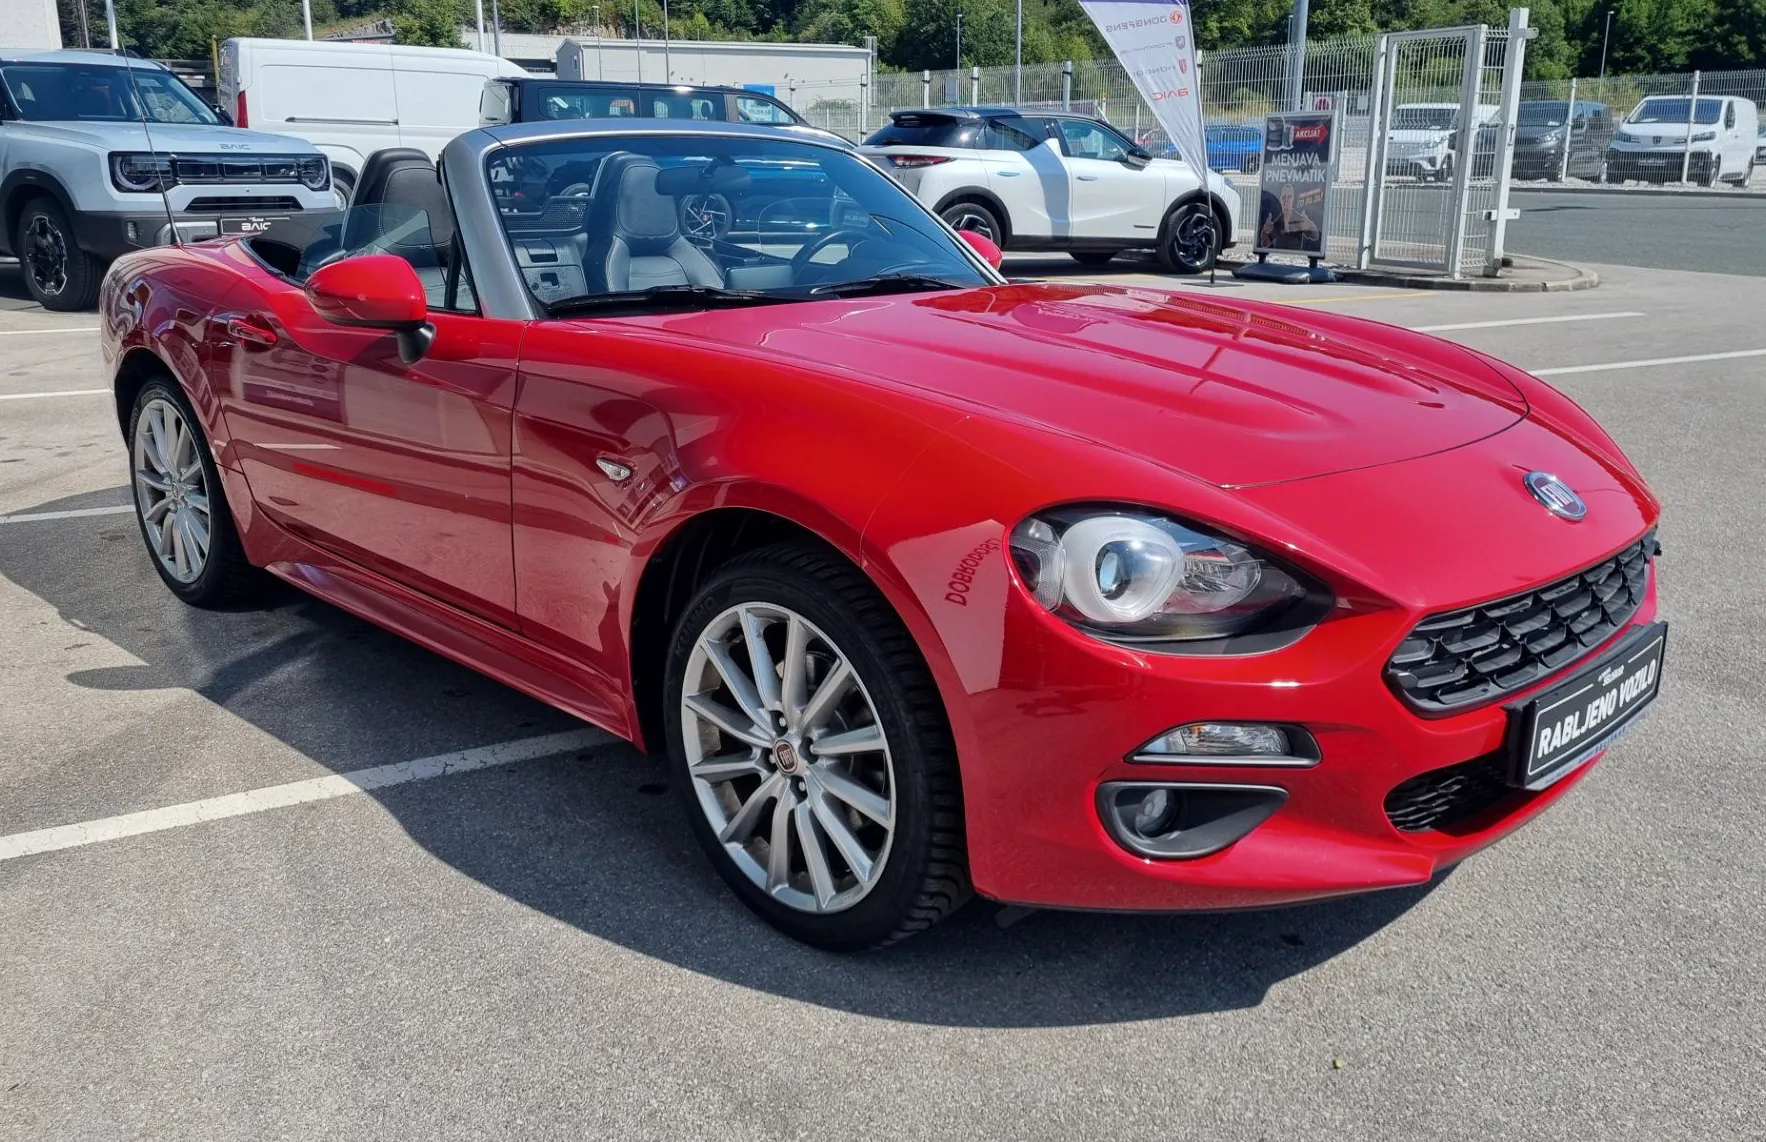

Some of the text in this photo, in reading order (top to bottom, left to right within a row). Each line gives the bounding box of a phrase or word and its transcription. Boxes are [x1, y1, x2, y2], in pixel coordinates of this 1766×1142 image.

[1295, 128, 1321, 139] AKCIJA!
[1271, 152, 1321, 166] MENJAVA
[1265, 169, 1326, 183] PNEVMATIK
[241, 221, 272, 231] BAIC
[1537, 688, 1618, 759] RABLJENO
[1618, 658, 1657, 708] VOZILO
